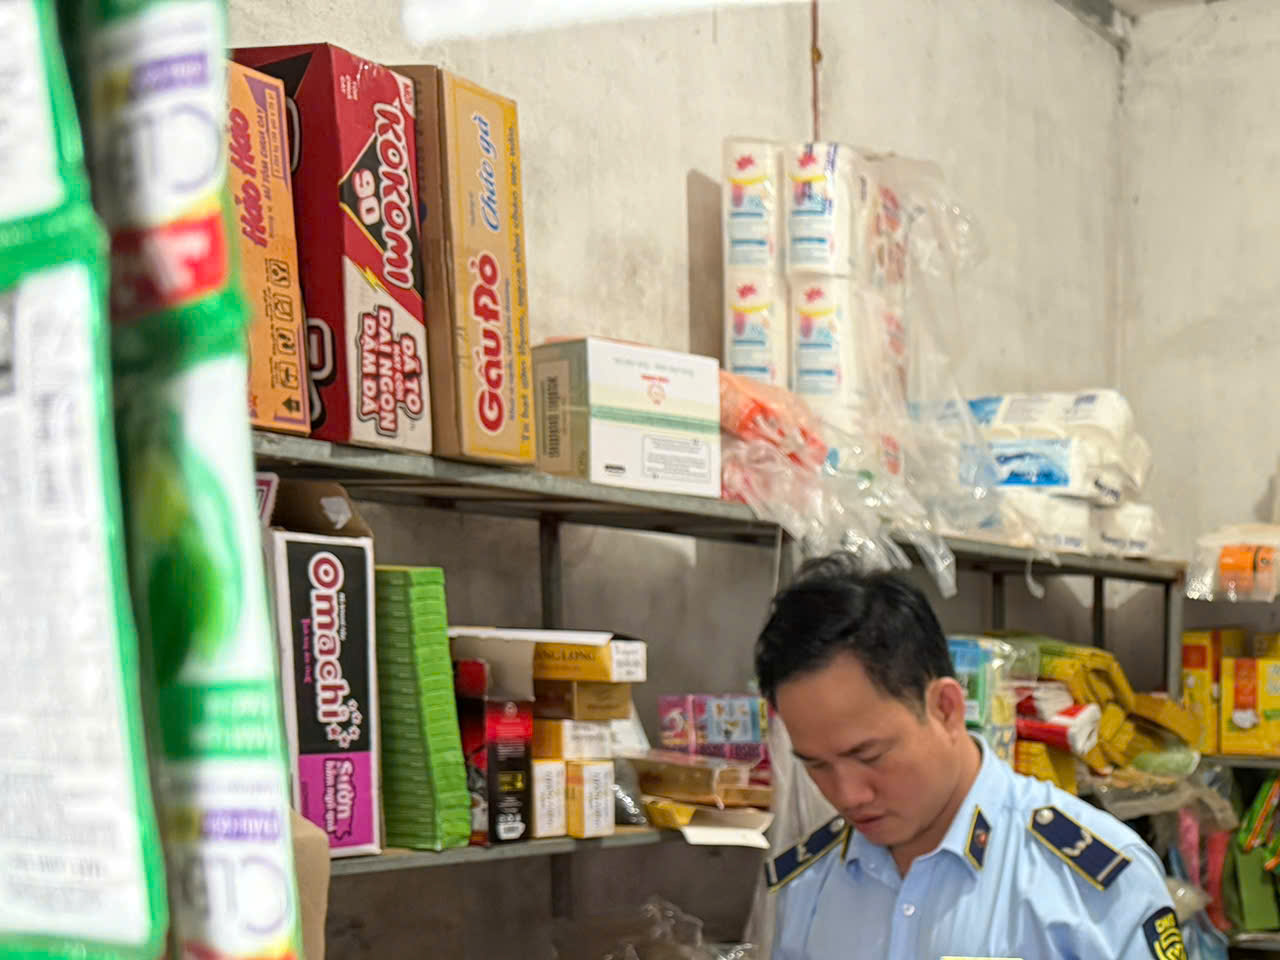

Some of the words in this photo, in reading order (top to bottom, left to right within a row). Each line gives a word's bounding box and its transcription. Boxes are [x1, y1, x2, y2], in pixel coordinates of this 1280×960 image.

[352, 168, 380, 226] 90
[374, 102, 414, 289] KOKOMI
[379, 357, 396, 430] NGON
[405, 376, 423, 414] TO
[474, 327, 505, 433] Gấu
[308, 552, 350, 722] Omachi
[336, 758, 355, 820] Sườn
